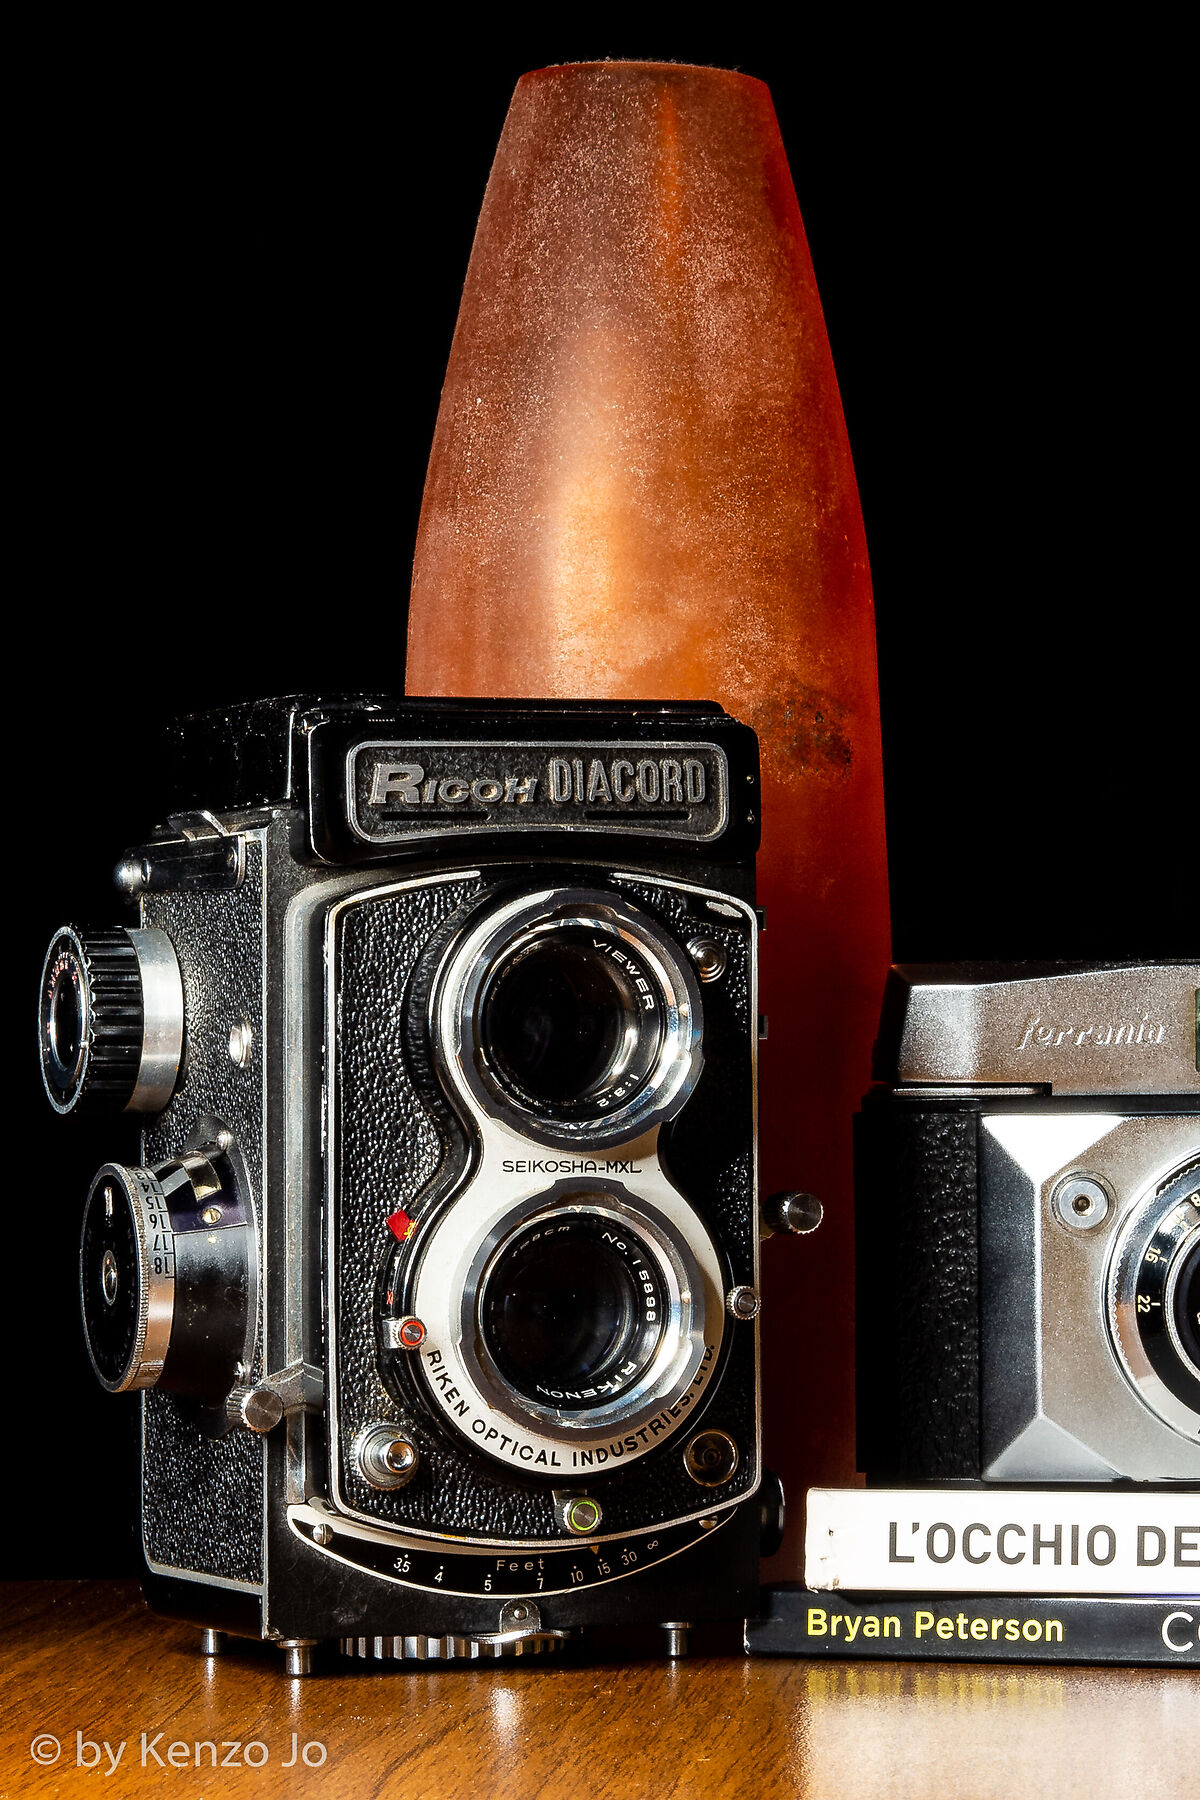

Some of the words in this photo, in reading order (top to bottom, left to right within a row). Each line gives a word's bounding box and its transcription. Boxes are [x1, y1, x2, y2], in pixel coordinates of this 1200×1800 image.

[552, 758, 706, 803] DIACORD
[593, 939, 655, 1010] VIEWER
[502, 1160, 642, 1174] SEIKOSHA-MXL
[142, 1182, 158, 1194] 14
[145, 1196, 164, 1210] 15
[149, 1213, 167, 1230] 16
[153, 1234, 169, 1251] 17
[602, 1232, 629, 1256] No.
[1145, 1246, 1162, 1264] 16
[154, 1257, 170, 1275] 18
[1138, 1294, 1151, 1313] 22
[536, 1361, 637, 1400] RIKENON
[426, 1350, 470, 1418] RIKEN
[471, 1418, 561, 1467] OPTICAL
[572, 1393, 695, 1467] INDUSTRIES,
[889, 1522, 1117, 1567] L'OCCHIO
[434, 1571, 443, 1584] 4
[484, 1579, 493, 1592] 5
[536, 1578, 544, 1591] 7
[571, 1570, 585, 1584] 10
[598, 1563, 612, 1577] 15
[621, 1551, 638, 1567] 30
[496, 1559, 545, 1573] Feet
[807, 1608, 901, 1642] Bryan
[914, 1610, 1064, 1642] Peterson
